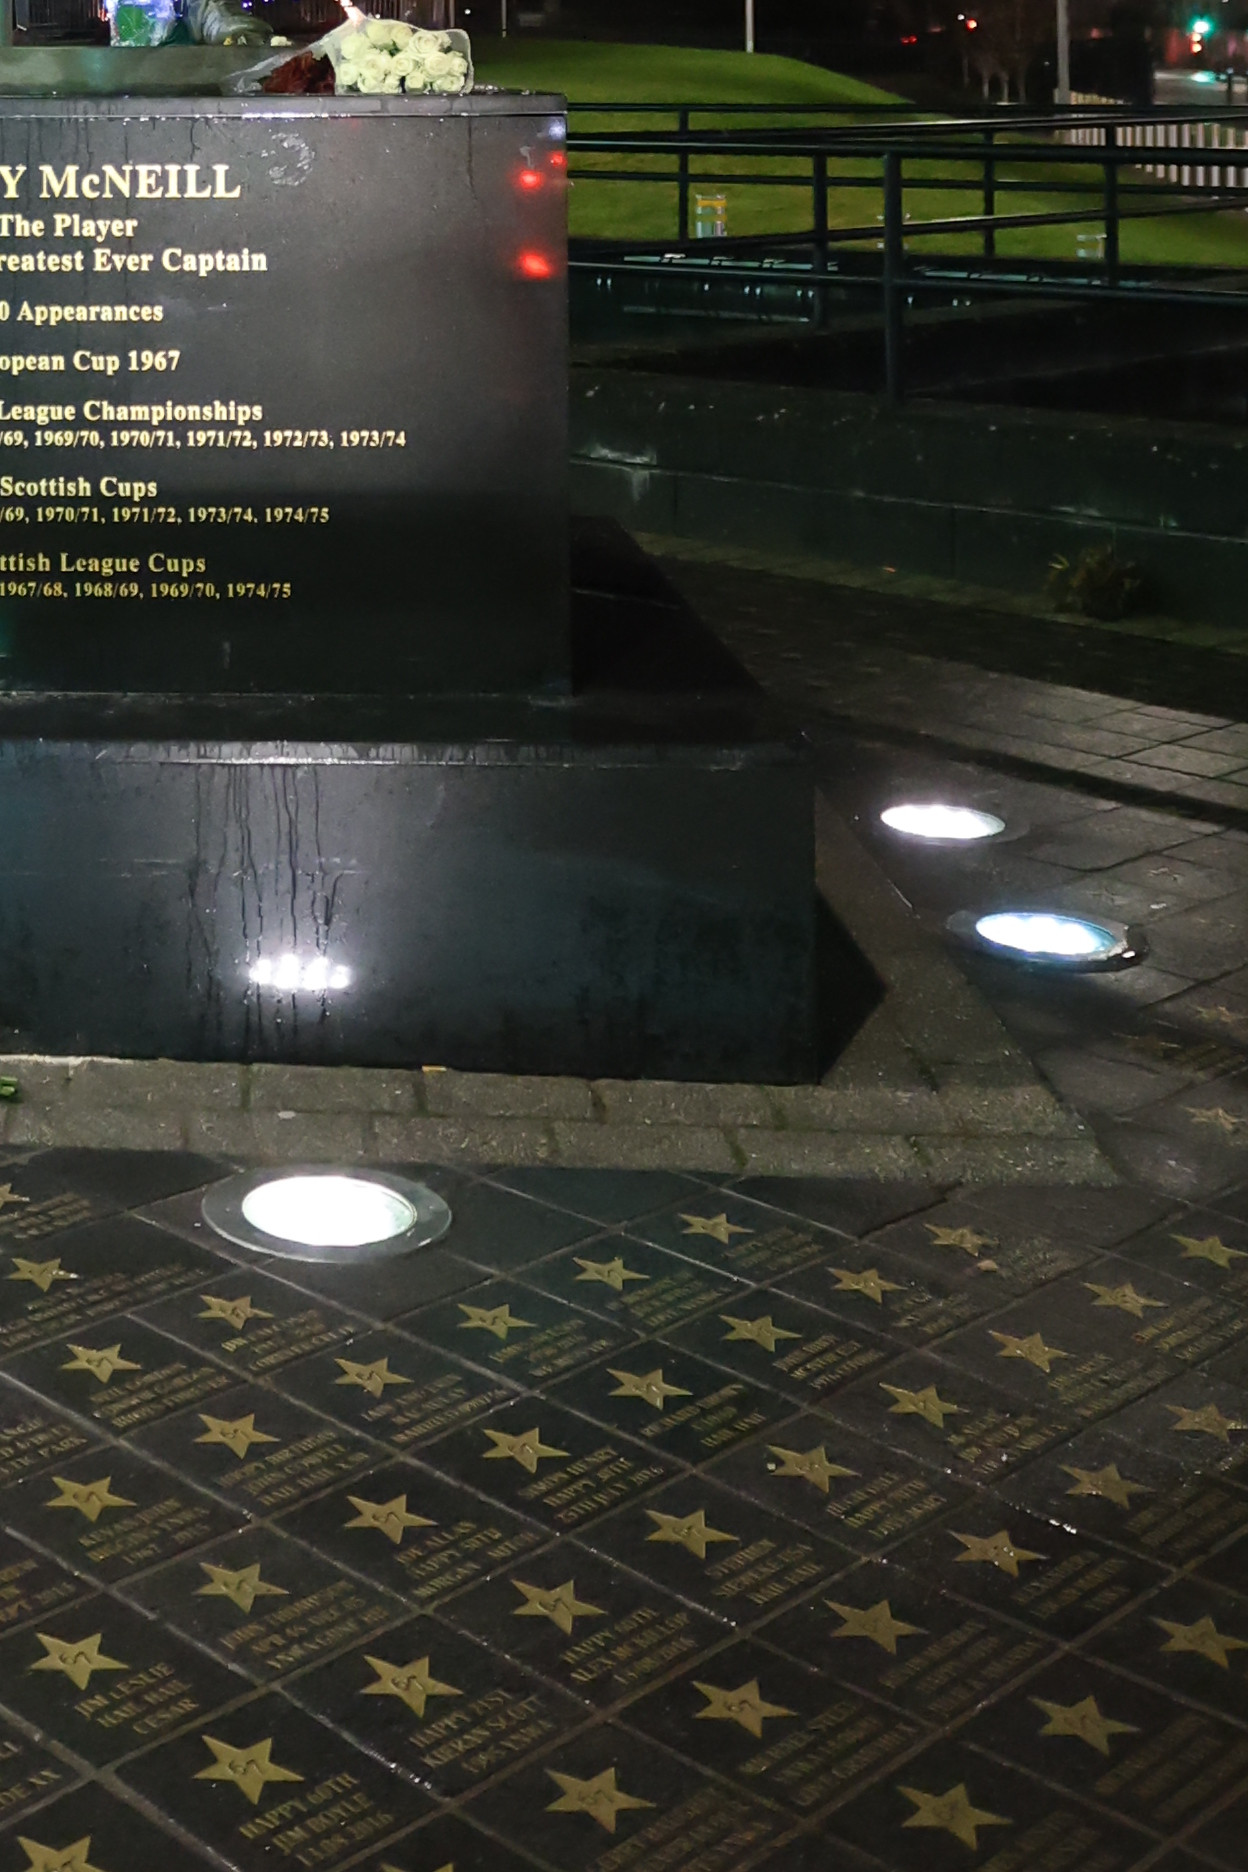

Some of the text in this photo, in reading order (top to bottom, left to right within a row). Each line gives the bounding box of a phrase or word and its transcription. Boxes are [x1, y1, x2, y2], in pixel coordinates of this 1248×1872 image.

[38, 160, 241, 199] McNEILL
[52, 213, 139, 243] Player
[92, 247, 154, 272] Ever
[161, 247, 268, 277] Captain
[16, 300, 164, 326] Appearances
[72, 349, 120, 376] Cup
[127, 349, 181, 372] 1967
[82, 399, 263, 426] Championships
[34, 429, 106, 449] 1969/70,
[110, 429, 182, 449] 1970/71,
[186, 429, 258, 450] 1971/72,
[340, 429, 407, 448] 1973/74
[0, 475, 92, 497] Scottish
[99, 476, 158, 503] Cups
[36, 506, 106, 525] 1970/71,
[112, 506, 183, 524] 1971/72,
[265, 506, 330, 523] 1974/75
[60, 552, 141, 577] League
[148, 552, 206, 578] Cups
[75, 581, 144, 600] 1968/69,
[151, 582, 220, 600] 1969/70,
[227, 582, 291, 599] 1974/75
[36, 1434, 88, 1458] PARK
[747, 1561, 825, 1604] HAIL HAIL
[558, 1630, 618, 1663] HAPPY
[73, 1694, 115, 1718] JIM
[95, 1677, 193, 1728] HAIL HAIL
[130, 1697, 200, 1735] CESAR
[407, 1710, 474, 1748] HAPPY
[237, 1798, 310, 1840] HAPPY
[268, 1792, 376, 1855] JIM BOYLE
